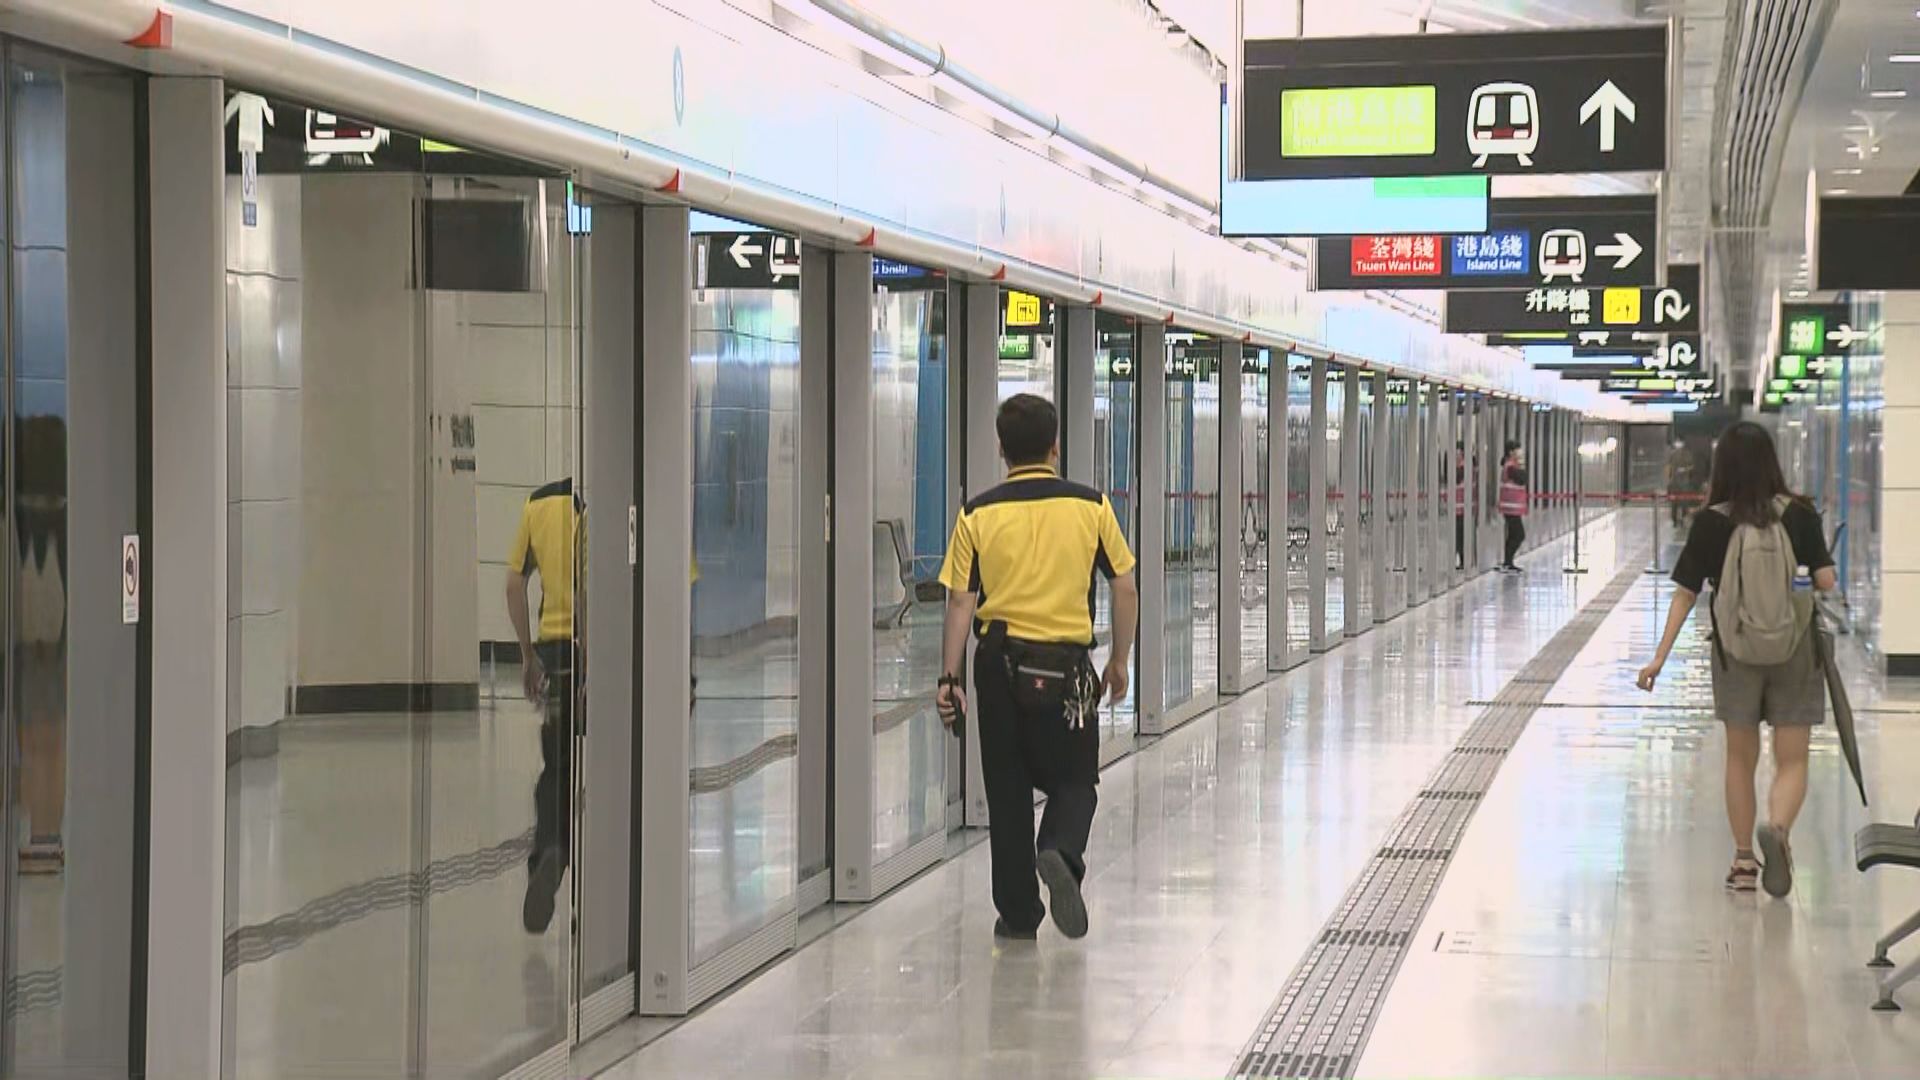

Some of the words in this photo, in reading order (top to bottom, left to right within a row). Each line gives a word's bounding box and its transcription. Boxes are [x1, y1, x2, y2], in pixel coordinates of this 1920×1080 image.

[1356, 261, 1387, 273] Tsuen
[1388, 261, 1412, 272] Wan
[1413, 261, 1435, 271] Line
[1466, 258, 1498, 271] Island
[1500, 259, 1522, 271] Line
